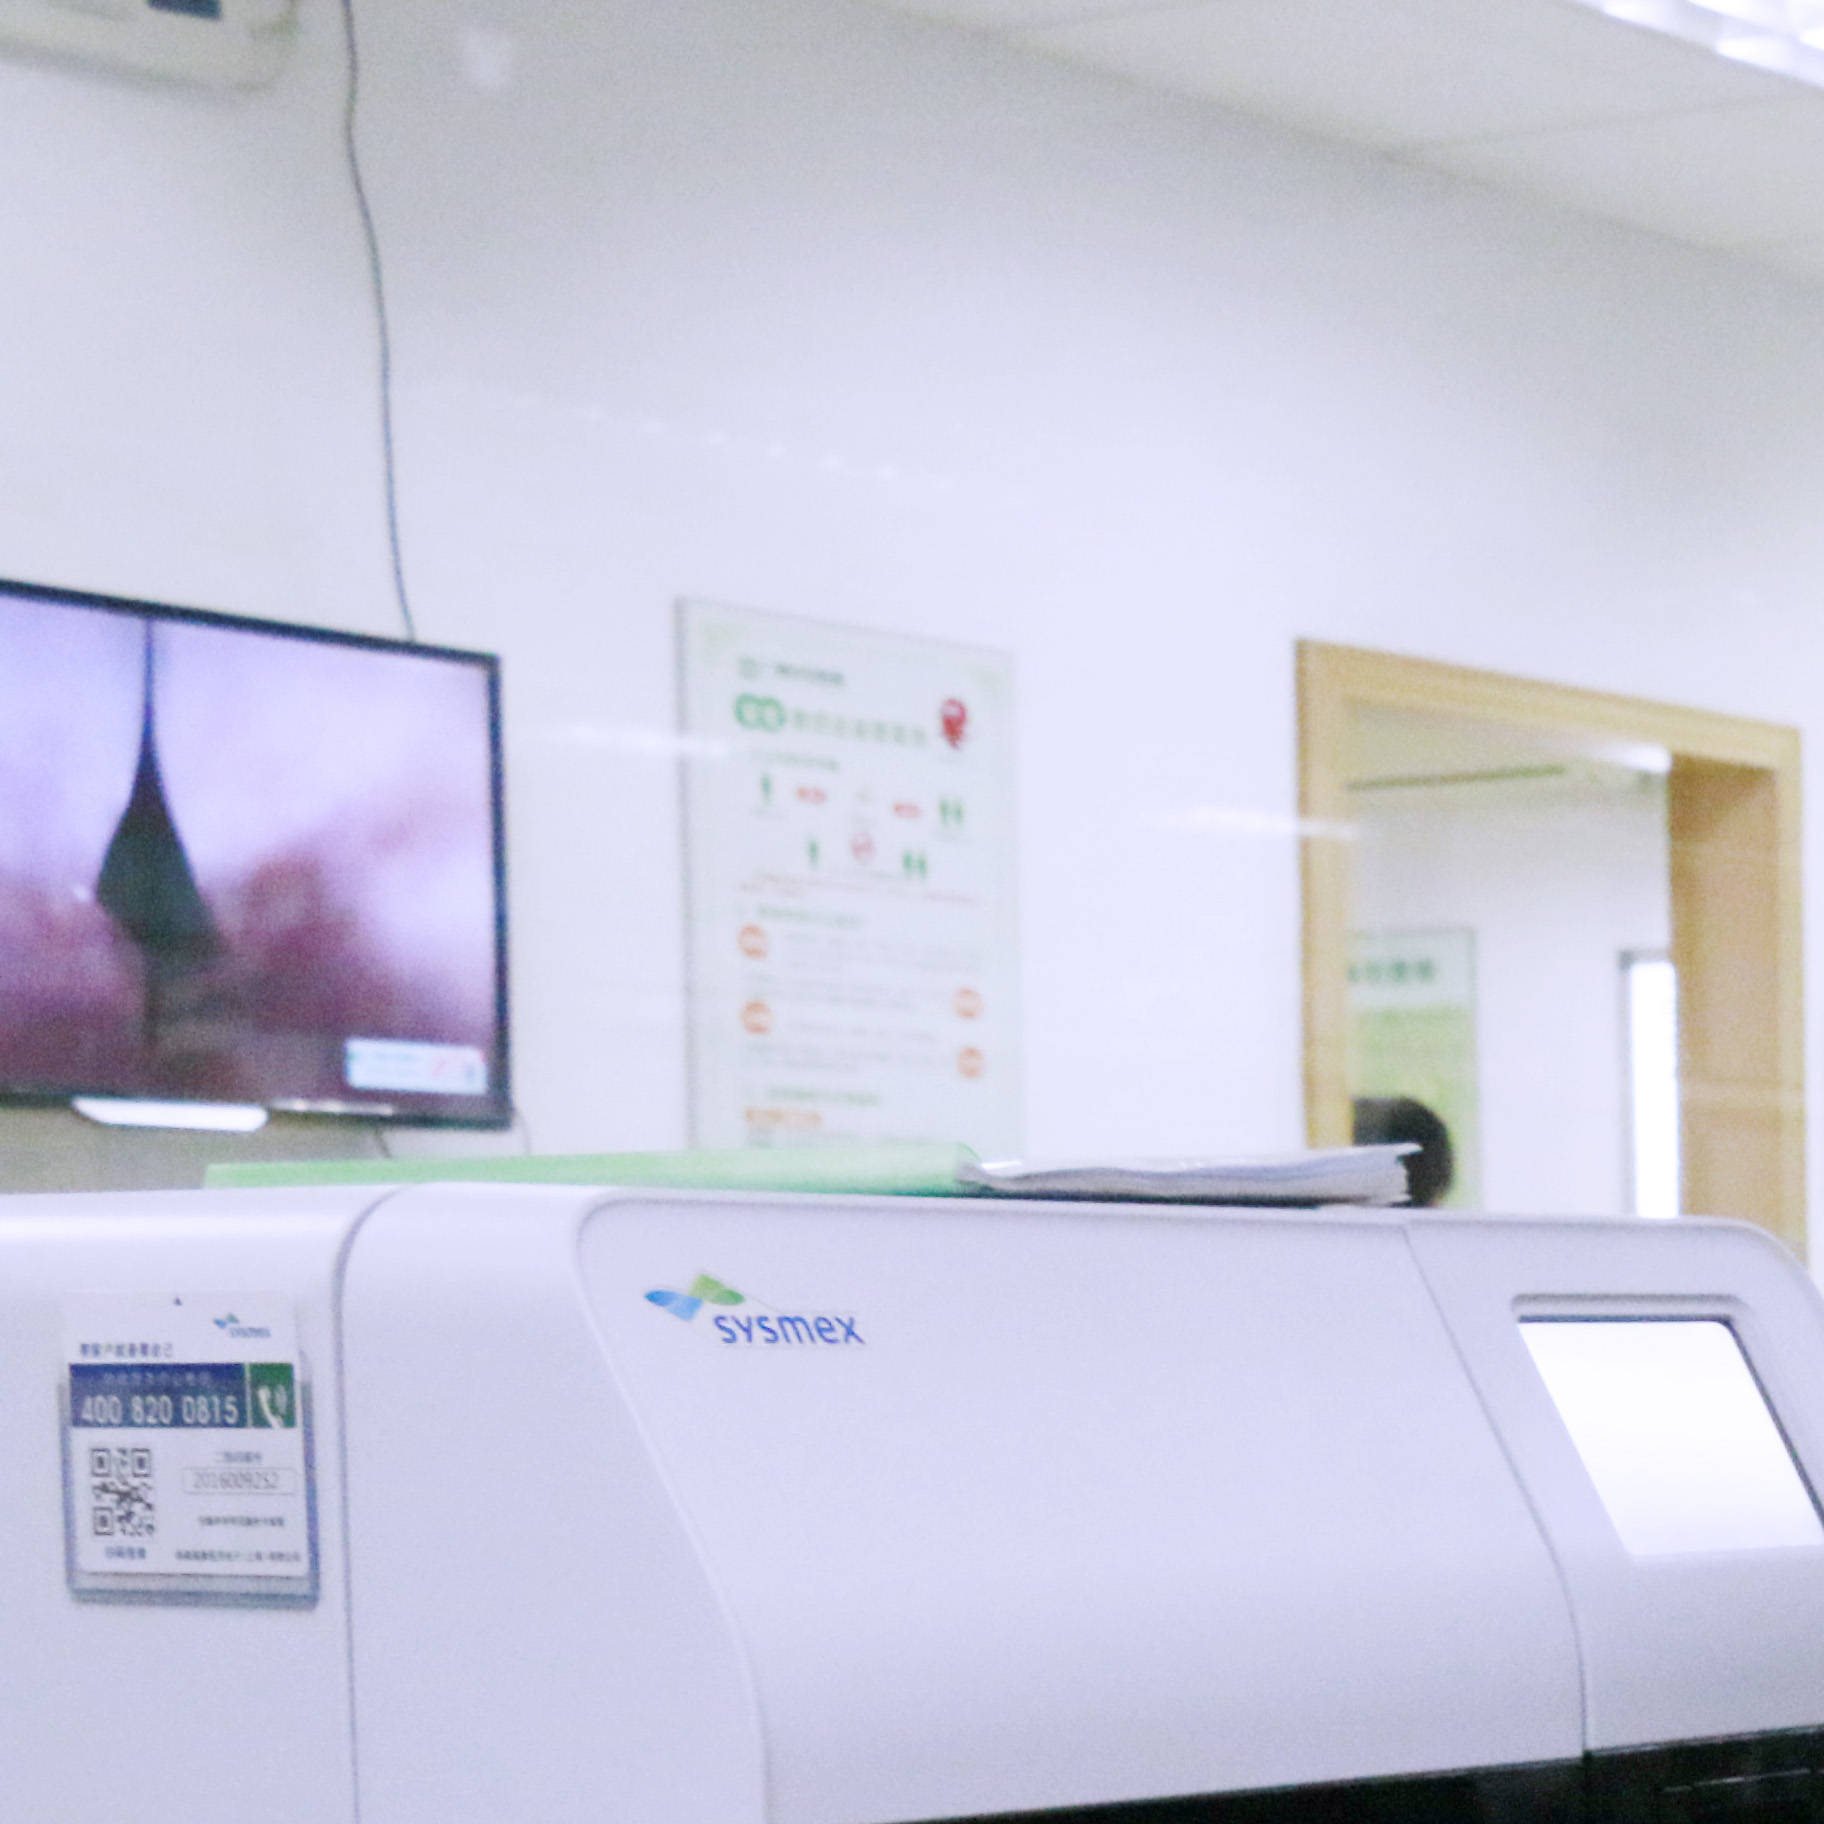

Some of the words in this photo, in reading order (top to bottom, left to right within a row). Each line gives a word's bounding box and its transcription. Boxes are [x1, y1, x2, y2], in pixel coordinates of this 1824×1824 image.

[713, 1315, 866, 1344] sysmex
[81, 1395, 123, 1424] 400
[131, 1395, 173, 1424] 820
[182, 1395, 239, 1424] 0815
